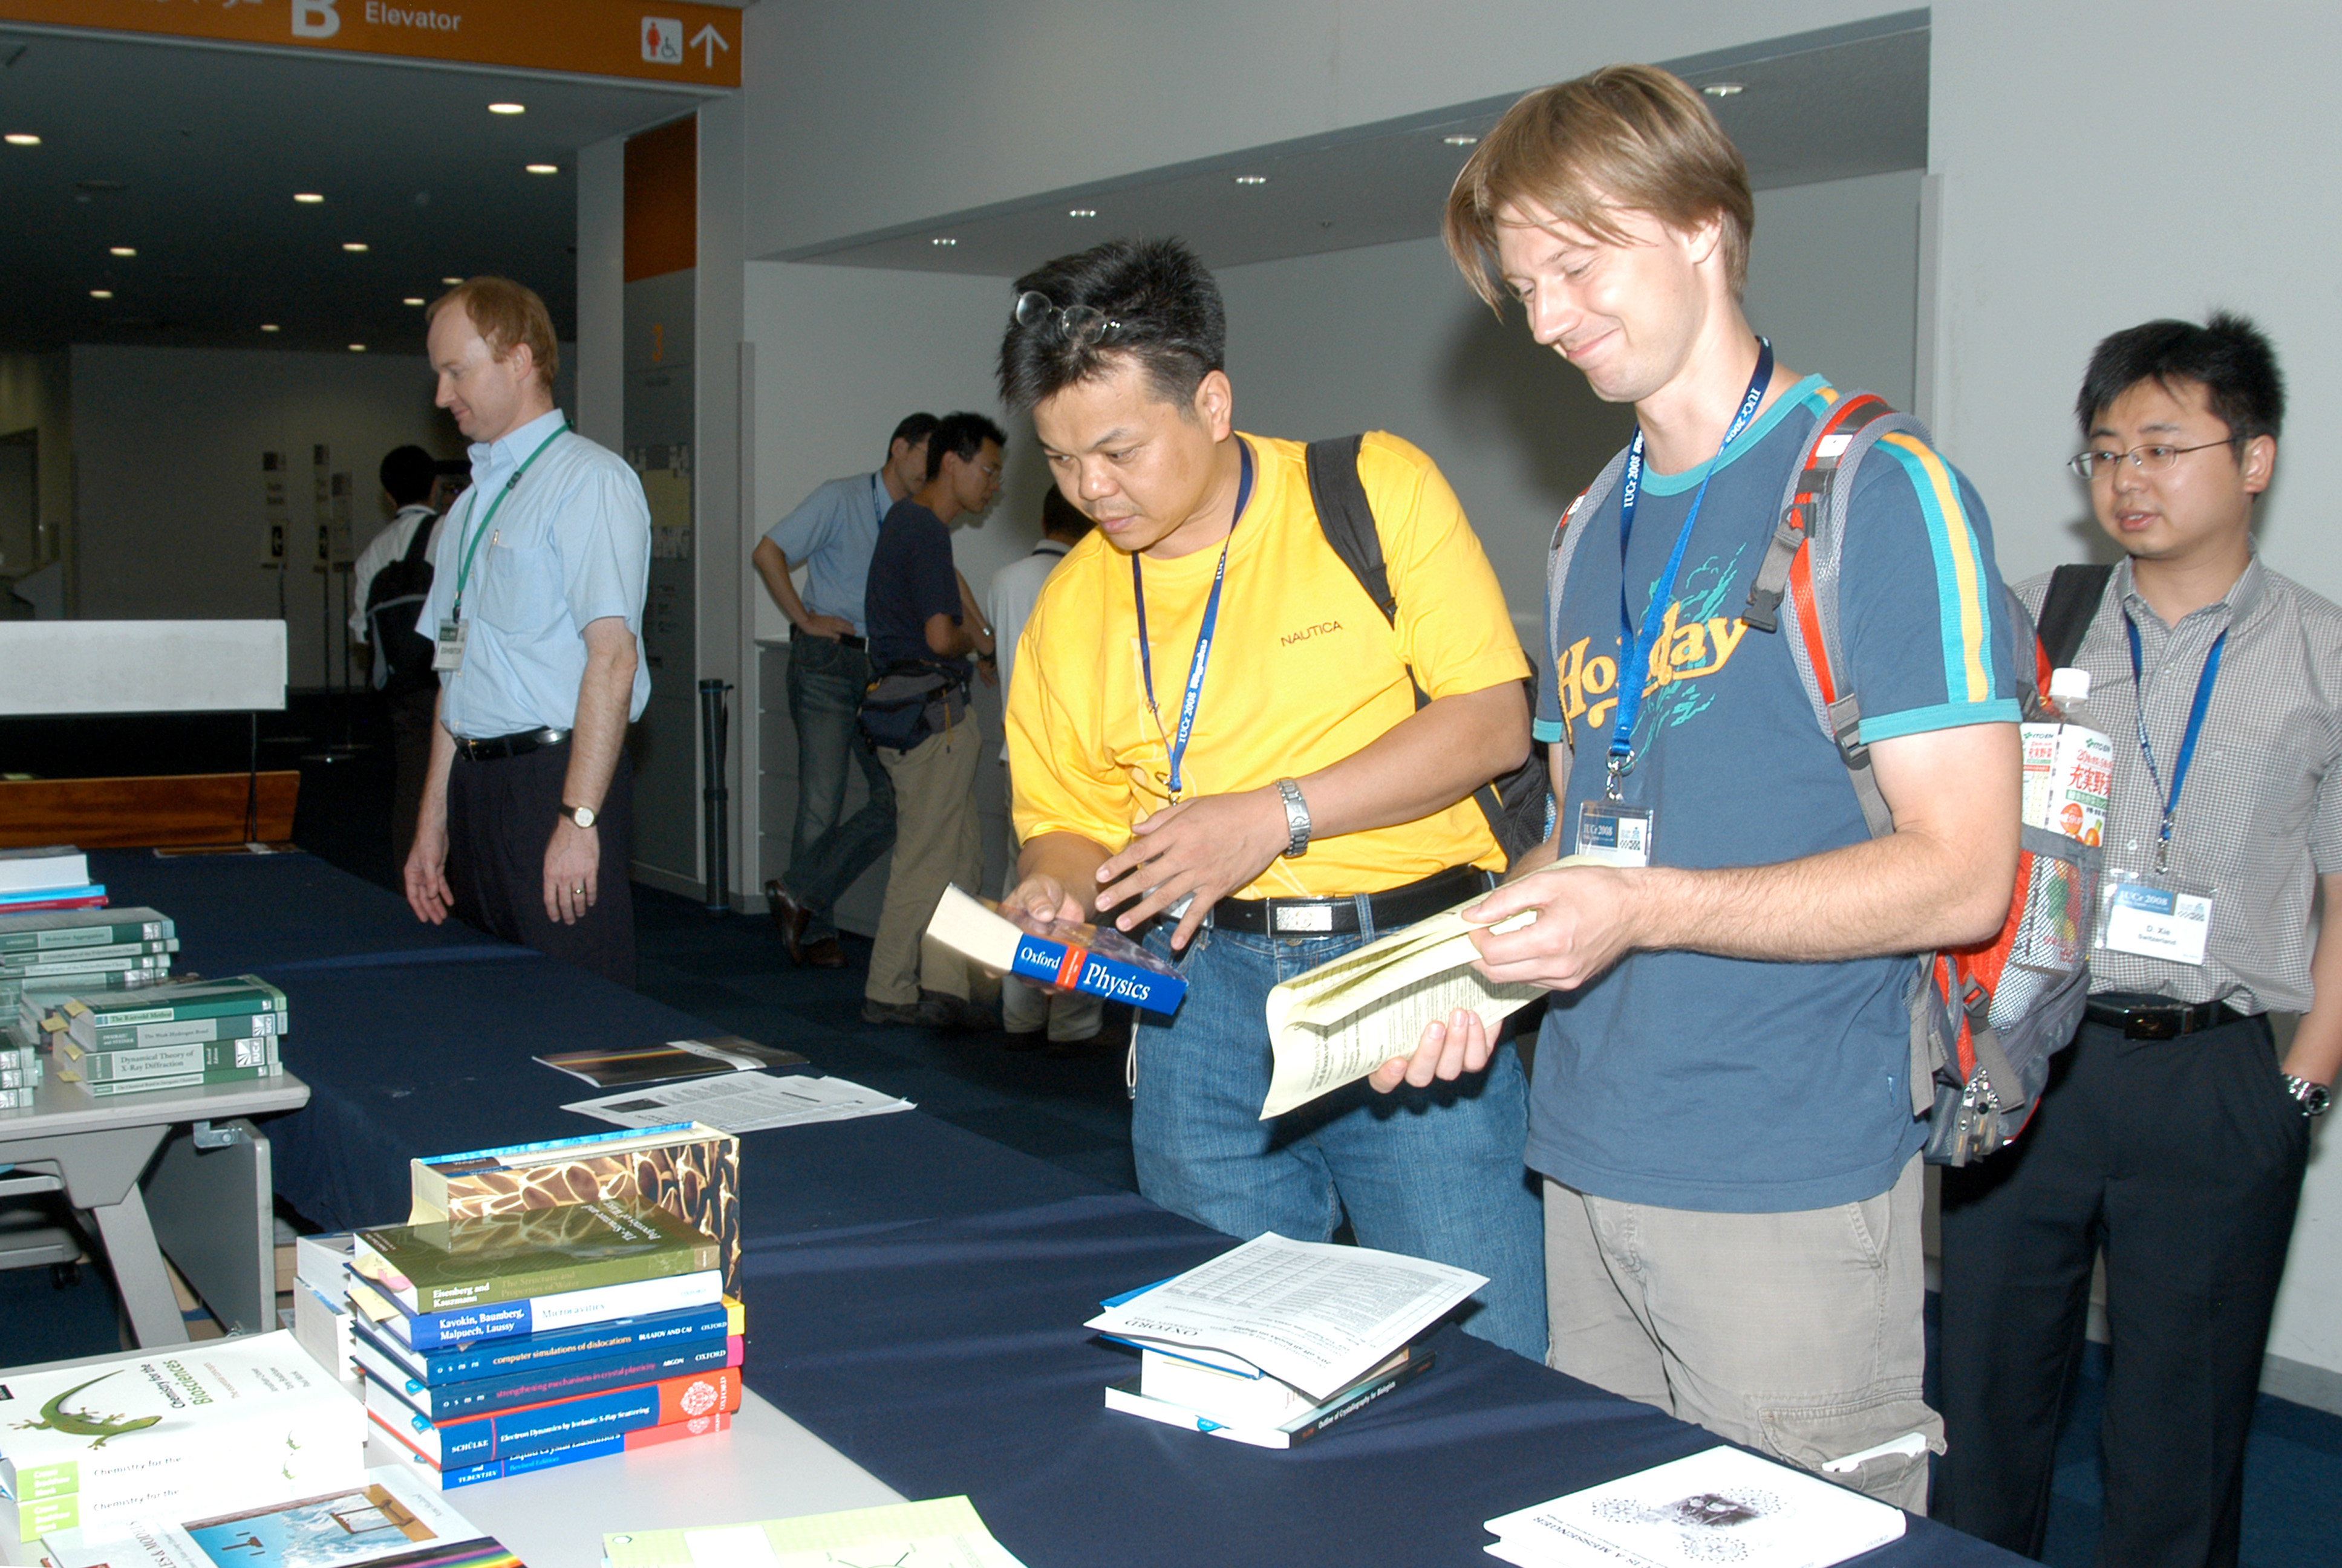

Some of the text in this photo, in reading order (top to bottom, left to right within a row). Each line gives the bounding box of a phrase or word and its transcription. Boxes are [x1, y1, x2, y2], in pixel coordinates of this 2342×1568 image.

[292, 0, 462, 38] B Elevator
[1724, 388, 1761, 443] IUCr 2008
[1627, 455, 1641, 480] 2008
[1623, 480, 1637, 508] IUCr
[1281, 620, 1343, 647] NAUTICA
[1558, 602, 1749, 729] Hoday
[1179, 691, 1196, 743] IUCr 2008
[2144, 894, 2168, 906] 2008
[2158, 927, 2170, 935] Xie
[1021, 947, 1061, 970] Oxford
[1083, 963, 1151, 1001] Physics
[121, 1054, 157, 1064] Dynamical
[160, 1051, 184, 1061] Theory
[251, 1041, 259, 1062] IUCr
[121, 1059, 184, 1073] X-Ray Diffraction
[520, 1274, 558, 1284] Structure
[433, 1283, 490, 1299] Eisenberg and
[501, 1281, 580, 1298] Properties of Water
[433, 1295, 478, 1307] Kauzmann
[543, 1304, 605, 1318] Microcavities
[439, 1309, 525, 1329] Kavokin, Baumberg,
[1124, 1319, 1198, 1336] OXFORD
[440, 1322, 515, 1341] Malpuech, Laussy
[492, 1353, 531, 1365] computer
[532, 1345, 576, 1358] simulations
[577, 1342, 586, 1350] of
[587, 1336, 631, 1350] dislocations
[639, 1331, 667, 1341] BULATOV
[667, 1328, 681, 1336] AND
[700, 1321, 727, 1330] OXFORD
[1302, 1347, 1316, 1356] off
[163, 1360, 214, 1405] Biosciences
[496, 1382, 547, 1398] strengthening
[547, 1374, 592, 1389] mechanisms
[593, 1372, 601, 1381] in
[601, 1367, 625, 1380] crystal
[625, 1362, 656, 1376] plasticity
[663, 1358, 685, 1367] ARGON
[695, 1350, 726, 1361] OXFORD
[158, 1381, 185, 1408] Chemistry
[1319, 1416, 1334, 1430] Outline
[1334, 1410, 1340, 1421] of
[1339, 1396, 1371, 1419] Crystallography
[1377, 1381, 1396, 1396] Biologists
[451, 1439, 489, 1453] SCHÜLKE
[501, 1429, 529, 1442] Electron
[530, 1425, 563, 1439] Dynamics
[563, 1422, 571, 1431] by
[599, 1411, 617, 1423] X-Ray
[618, 1406, 650, 1419] Scattering
[94, 1463, 145, 1476] Chemistry
[472, 1464, 484, 1472] and
[510, 1456, 559, 1471] Revised Edition
[94, 1497, 144, 1511] Chemistry
[1533, 1517, 1612, 1553] MESSENGER
